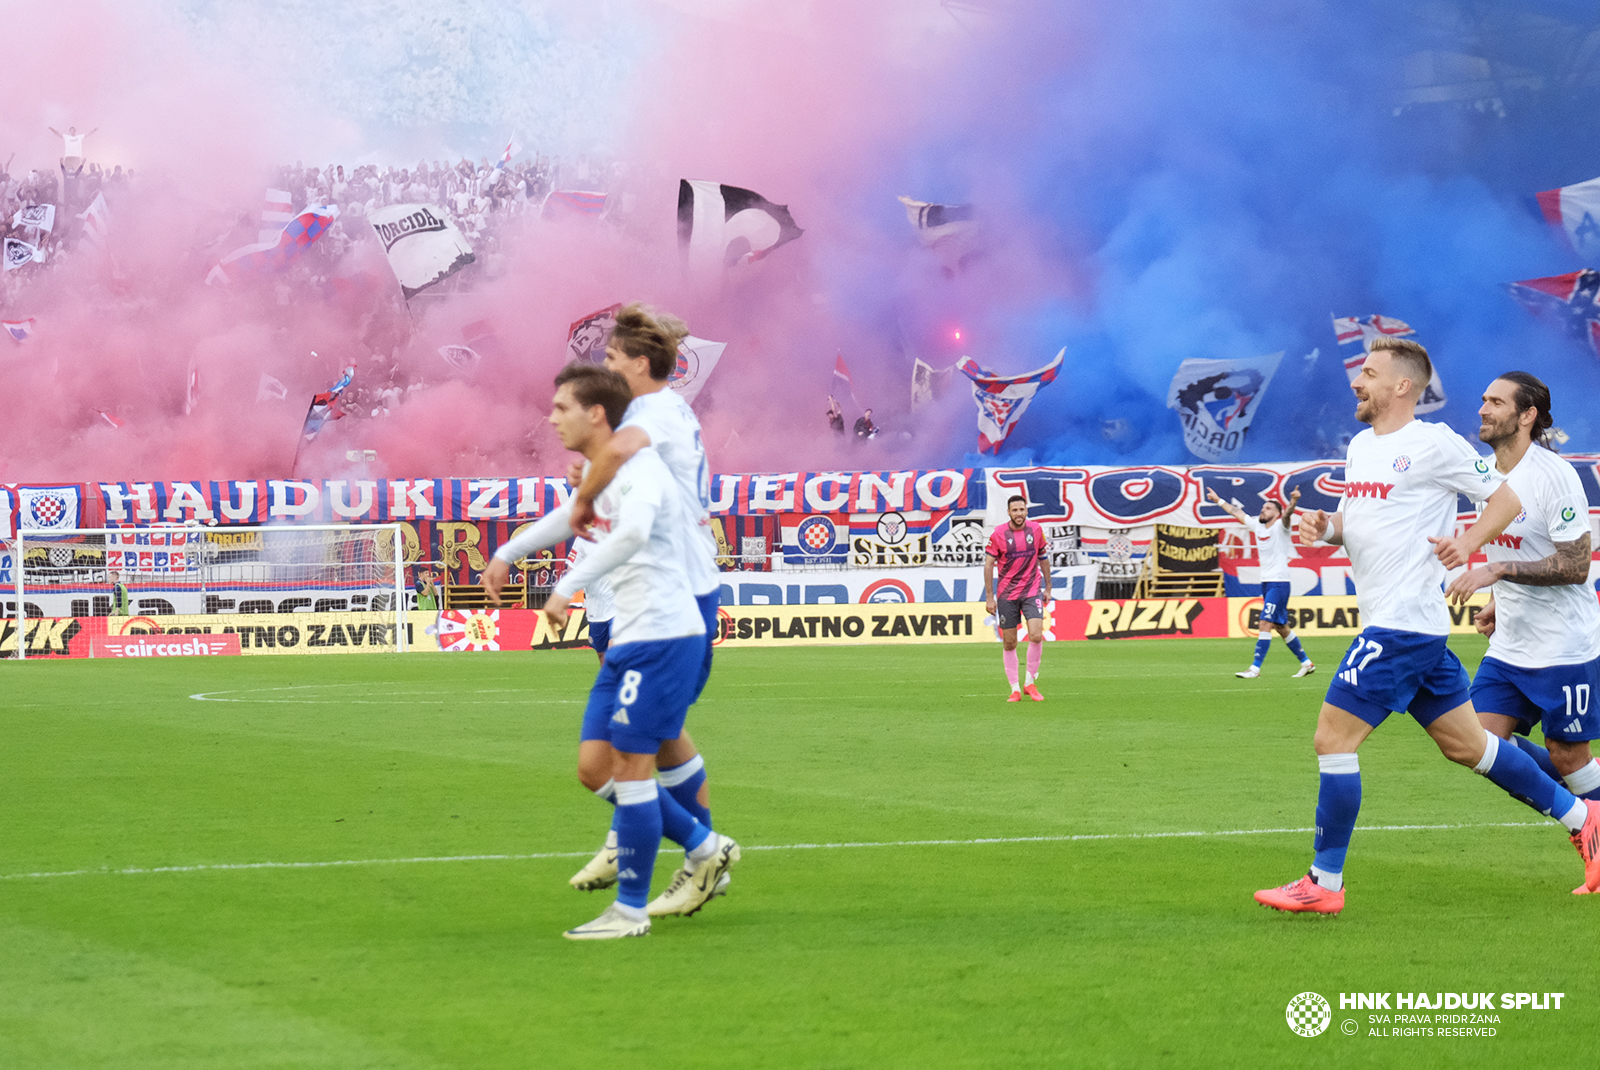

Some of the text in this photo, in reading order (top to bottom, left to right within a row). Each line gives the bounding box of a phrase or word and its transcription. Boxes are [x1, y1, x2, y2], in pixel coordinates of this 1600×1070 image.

[101, 479, 437, 519] HAJDUK
[1345, 481, 1395, 500] OMMY
[854, 535, 928, 565] SINJ
[1033, 598, 1043, 610] 9
[1264, 602, 1276, 615] 31
[871, 614, 972, 637] ZAVRTI
[1085, 600, 1200, 637] RIZK
[124, 638, 207, 656] aircash
[307, 623, 413, 647] ZAVRTI
[1346, 636, 1383, 671] 17
[619, 669, 642, 705] 8
[1562, 684, 1590, 716] 10
